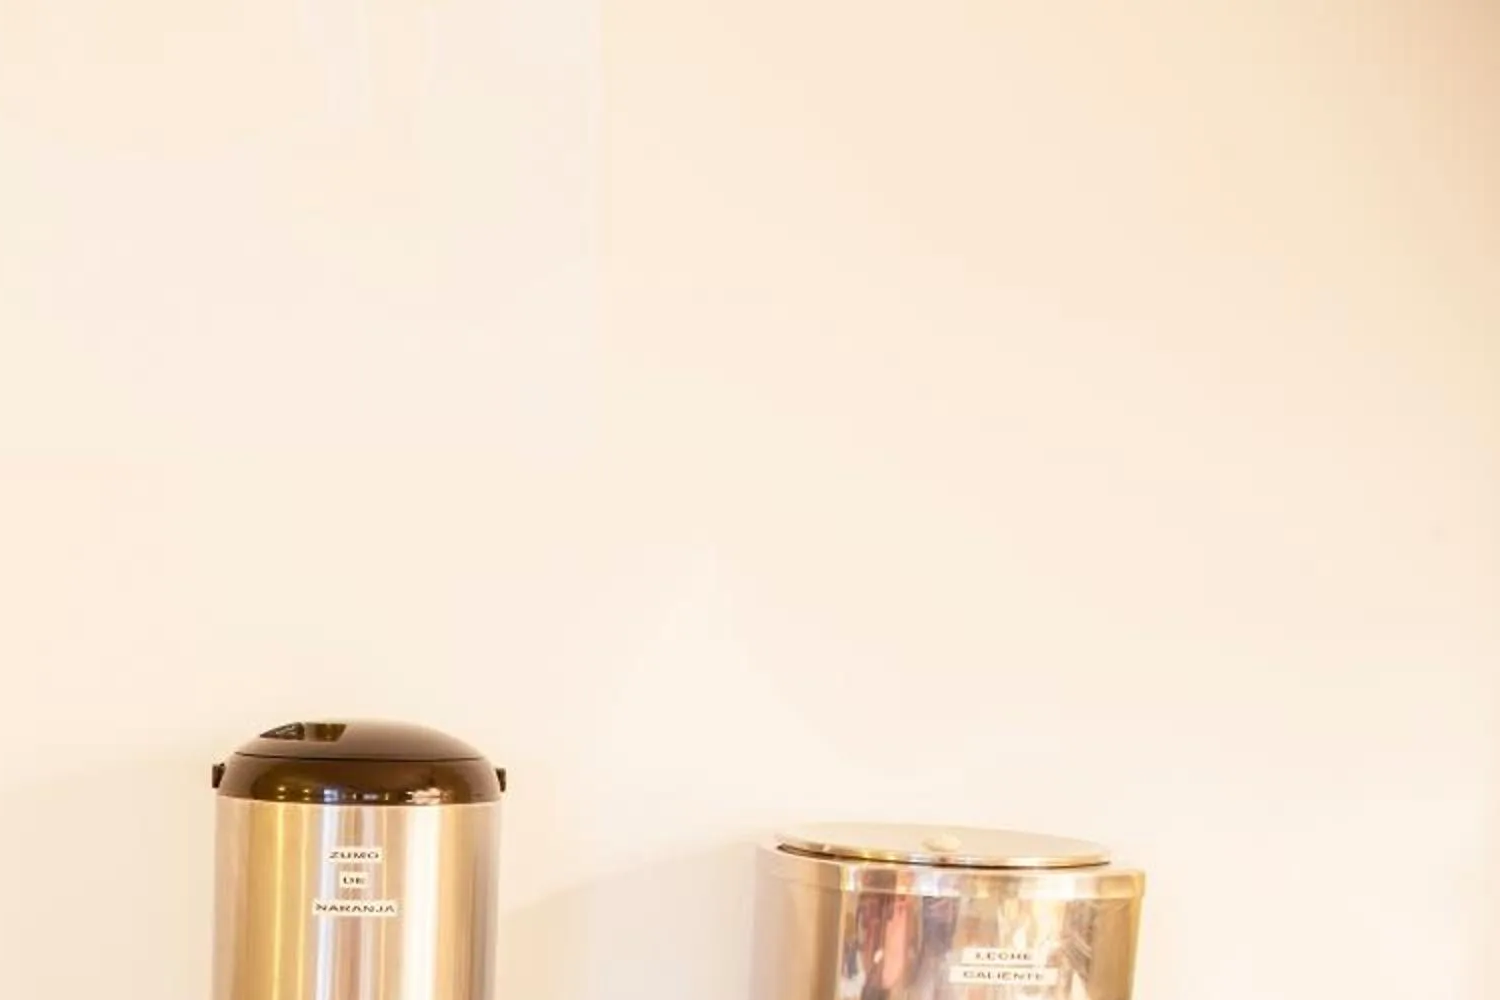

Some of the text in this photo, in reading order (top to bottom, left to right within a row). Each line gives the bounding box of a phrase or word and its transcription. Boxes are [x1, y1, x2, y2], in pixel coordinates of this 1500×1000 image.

[328, 850, 380, 860] ZUMO
[342, 876, 366, 885] DE
[315, 903, 396, 914] NARANJA
[974, 951, 1032, 961] LECHE
[962, 970, 1045, 981] CALIENTE
